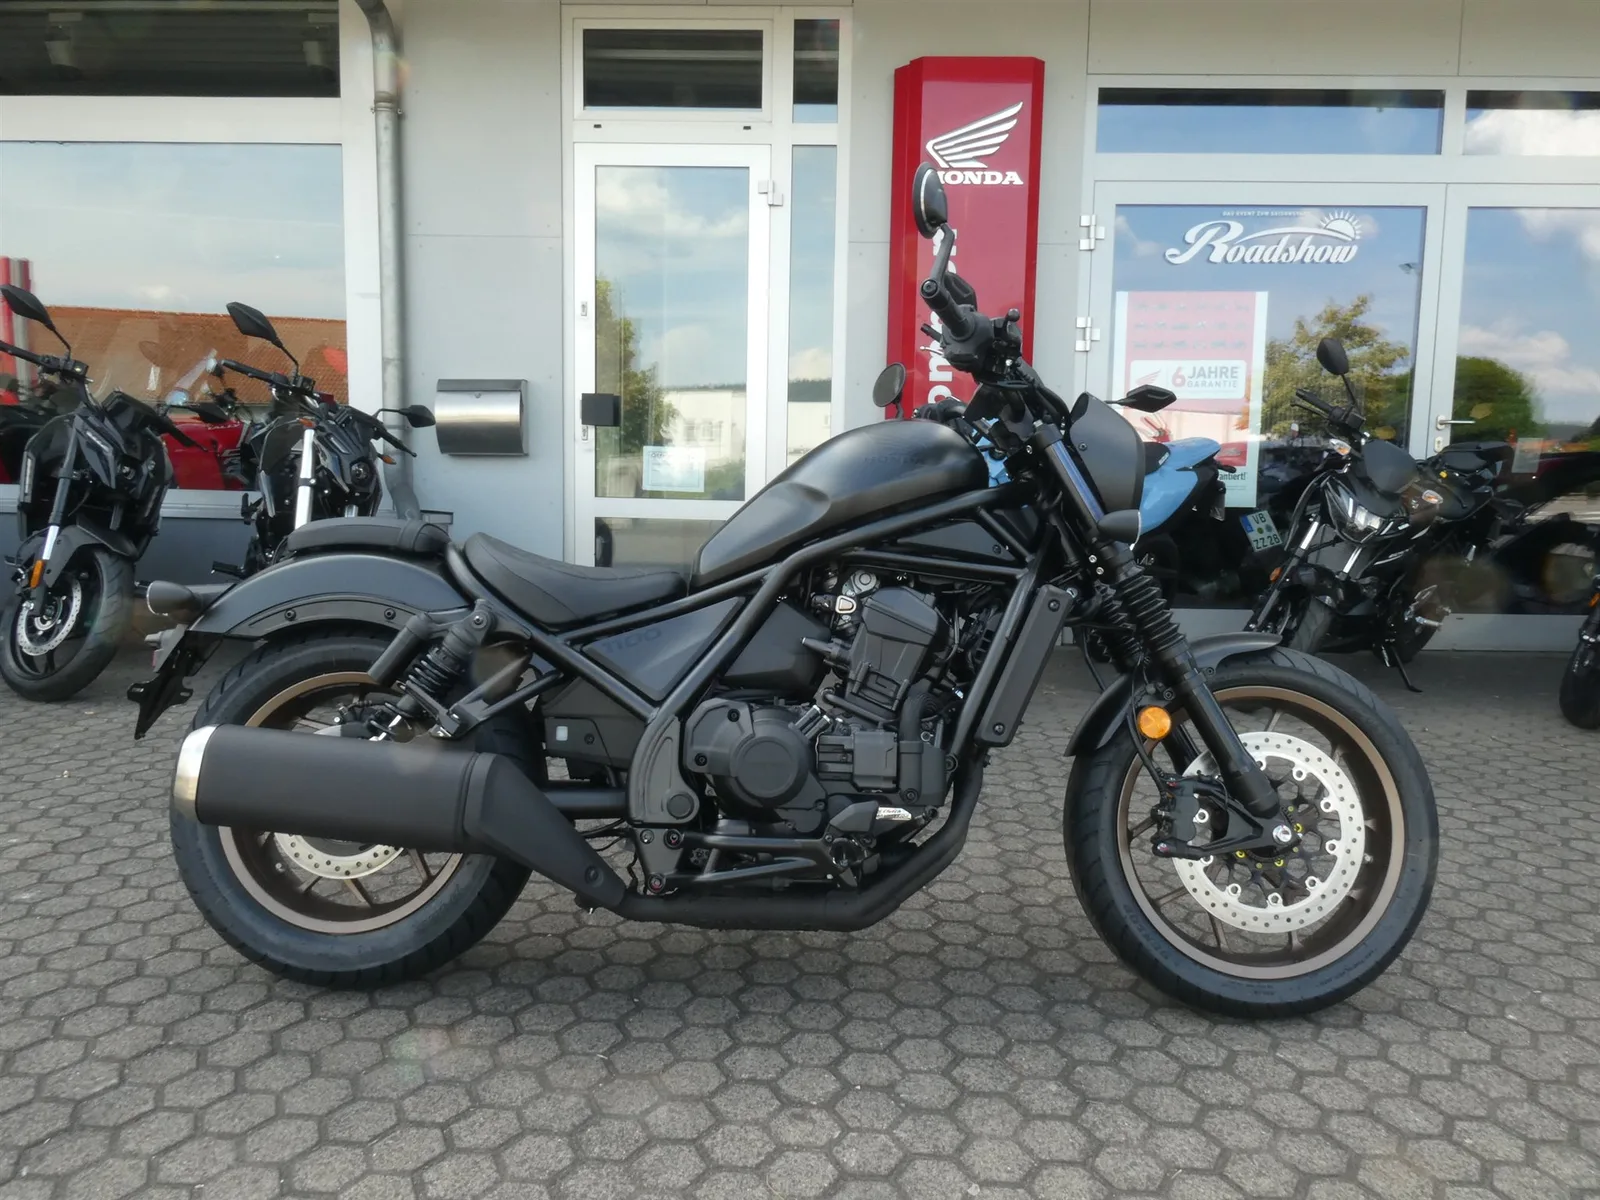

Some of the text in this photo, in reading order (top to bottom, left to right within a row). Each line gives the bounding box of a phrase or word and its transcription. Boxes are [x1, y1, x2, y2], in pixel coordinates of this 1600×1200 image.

[1165, 219, 1358, 265] Roadshow
[1171, 366, 1239, 387] 6 JAHRE
[1187, 380, 1237, 388] GARANTIE
[1252, 513, 1266, 524] VB
[1267, 534, 1280, 545] 28
